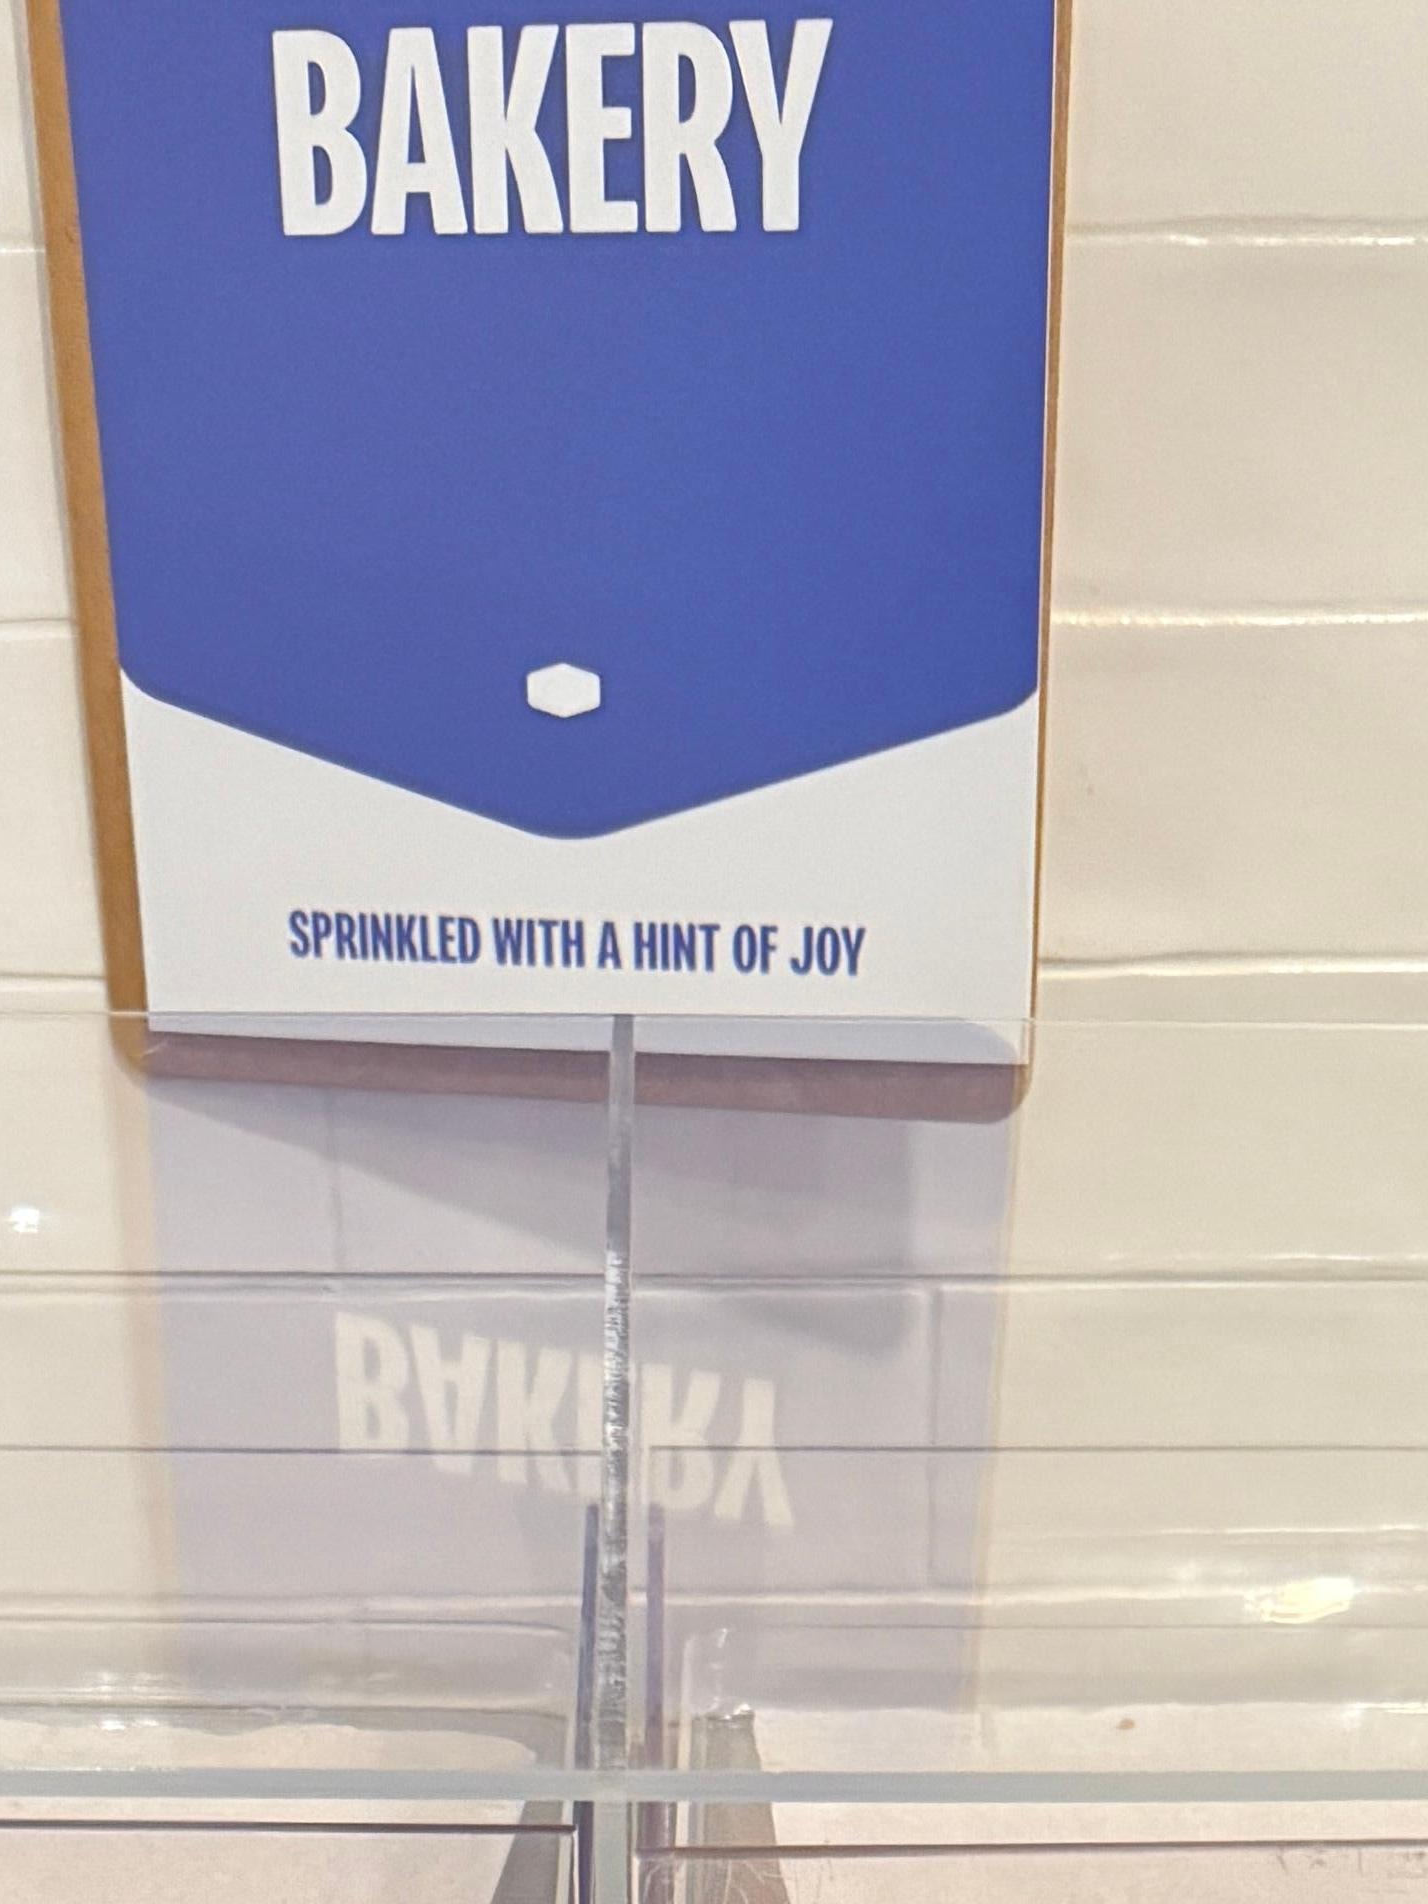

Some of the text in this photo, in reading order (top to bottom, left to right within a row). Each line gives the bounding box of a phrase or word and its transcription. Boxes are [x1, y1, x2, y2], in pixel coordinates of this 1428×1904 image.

[272, 18, 834, 236] BAKERY
[288, 910, 866, 976] SPRINKLED WITH A HINT OF JOY
